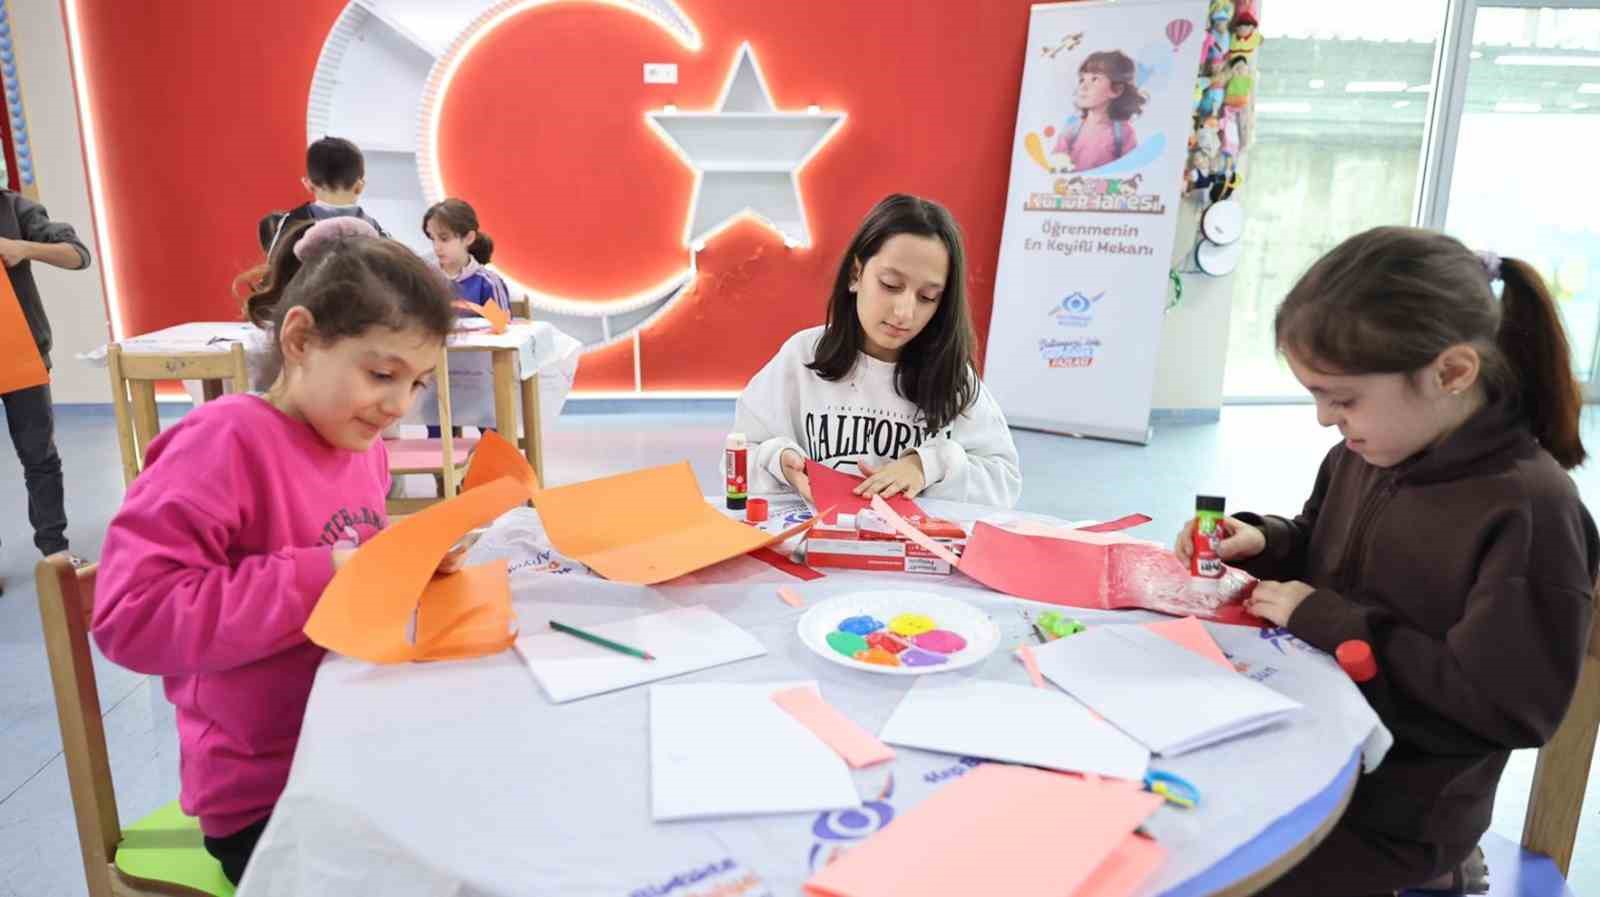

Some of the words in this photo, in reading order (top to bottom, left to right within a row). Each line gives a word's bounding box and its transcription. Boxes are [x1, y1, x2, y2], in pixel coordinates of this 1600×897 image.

[1041, 217, 1139, 238] Öğrenmenin
[1024, 238, 1042, 251] En
[1046, 239, 1093, 256] Keyifli
[1097, 240, 1154, 256] Mekanı
[805, 412, 952, 463] CALIFORN
